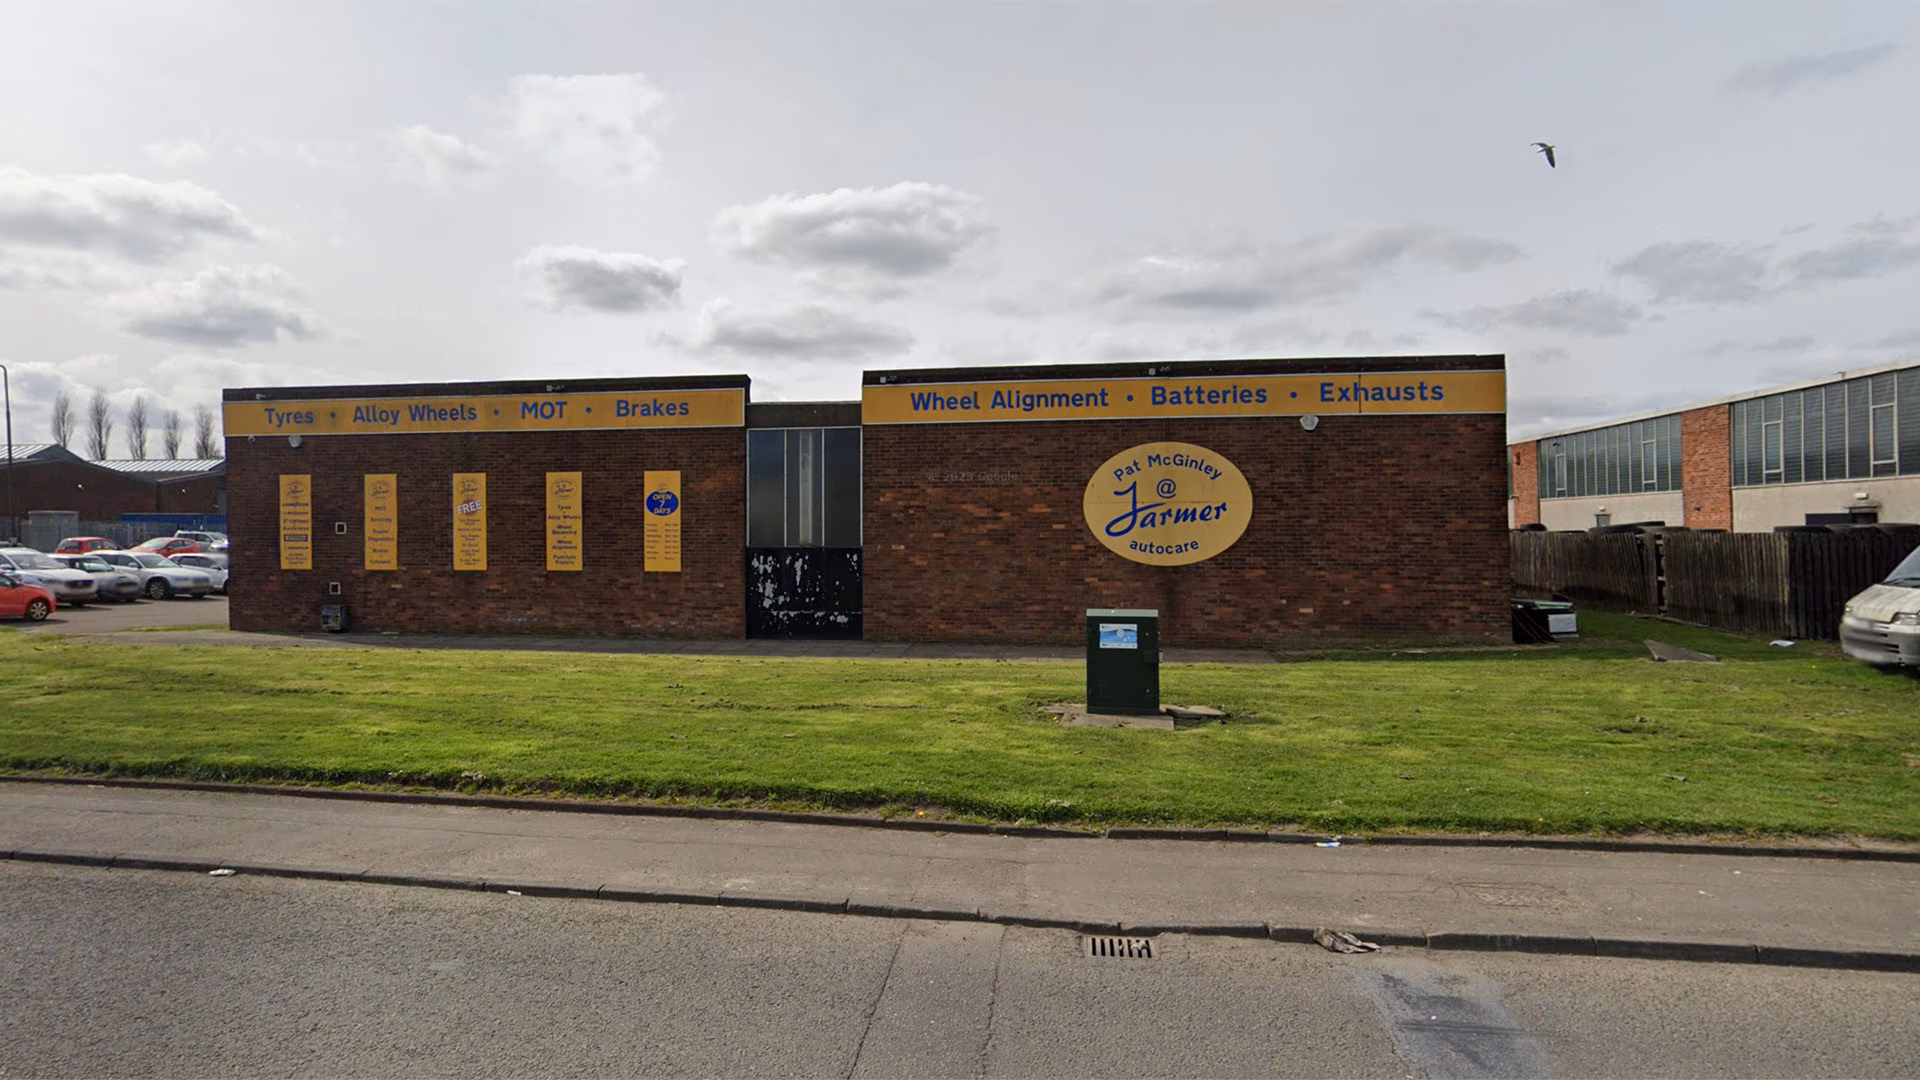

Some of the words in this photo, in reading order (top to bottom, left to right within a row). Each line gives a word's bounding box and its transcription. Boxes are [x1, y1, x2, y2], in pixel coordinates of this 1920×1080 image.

[910, 391, 980, 411] Wheel
[990, 388, 1109, 412] Alignment
[1151, 385, 1268, 405] Batteries
[1320, 381, 1444, 402] Exhausts
[264, 408, 314, 428] Tyres
[353, 406, 400, 426] Alloy
[408, 403, 477, 422] Wheels
[521, 401, 567, 420] MOT
[616, 399, 690, 417] Brakes
[1113, 460, 1141, 482] Pat
[1147, 453, 1222, 481] McGinley
[1156, 478, 1177, 499] @
[457, 499, 483, 515] FREE
[659, 500, 665, 508] 7
[1104, 480, 1227, 537] Jarmer
[1129, 540, 1199, 554] autocare
